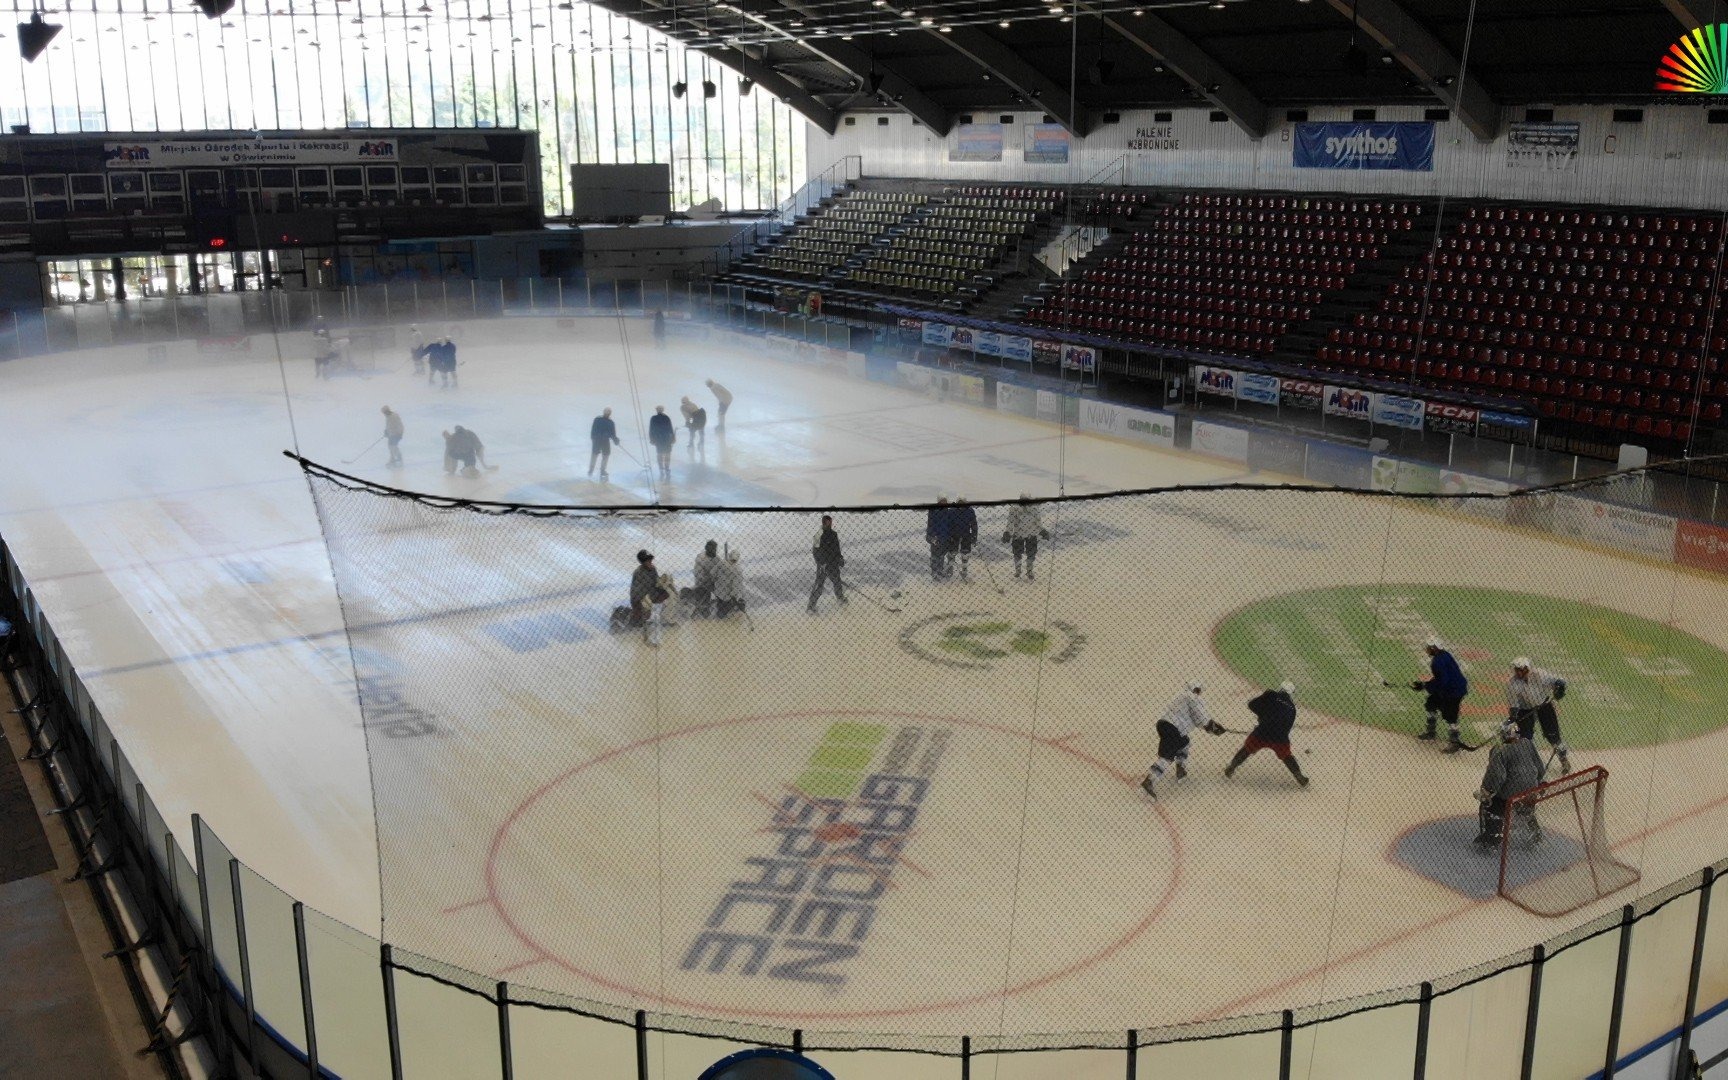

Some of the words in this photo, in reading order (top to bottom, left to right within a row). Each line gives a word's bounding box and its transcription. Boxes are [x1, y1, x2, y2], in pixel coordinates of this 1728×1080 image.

[1136, 127, 1171, 137] PALENIE
[1127, 139, 1179, 149] WZBRONIONE
[1325, 129, 1397, 160] synthos
[1281, 381, 1322, 394] CCM
[1426, 402, 1475, 420] CCM
